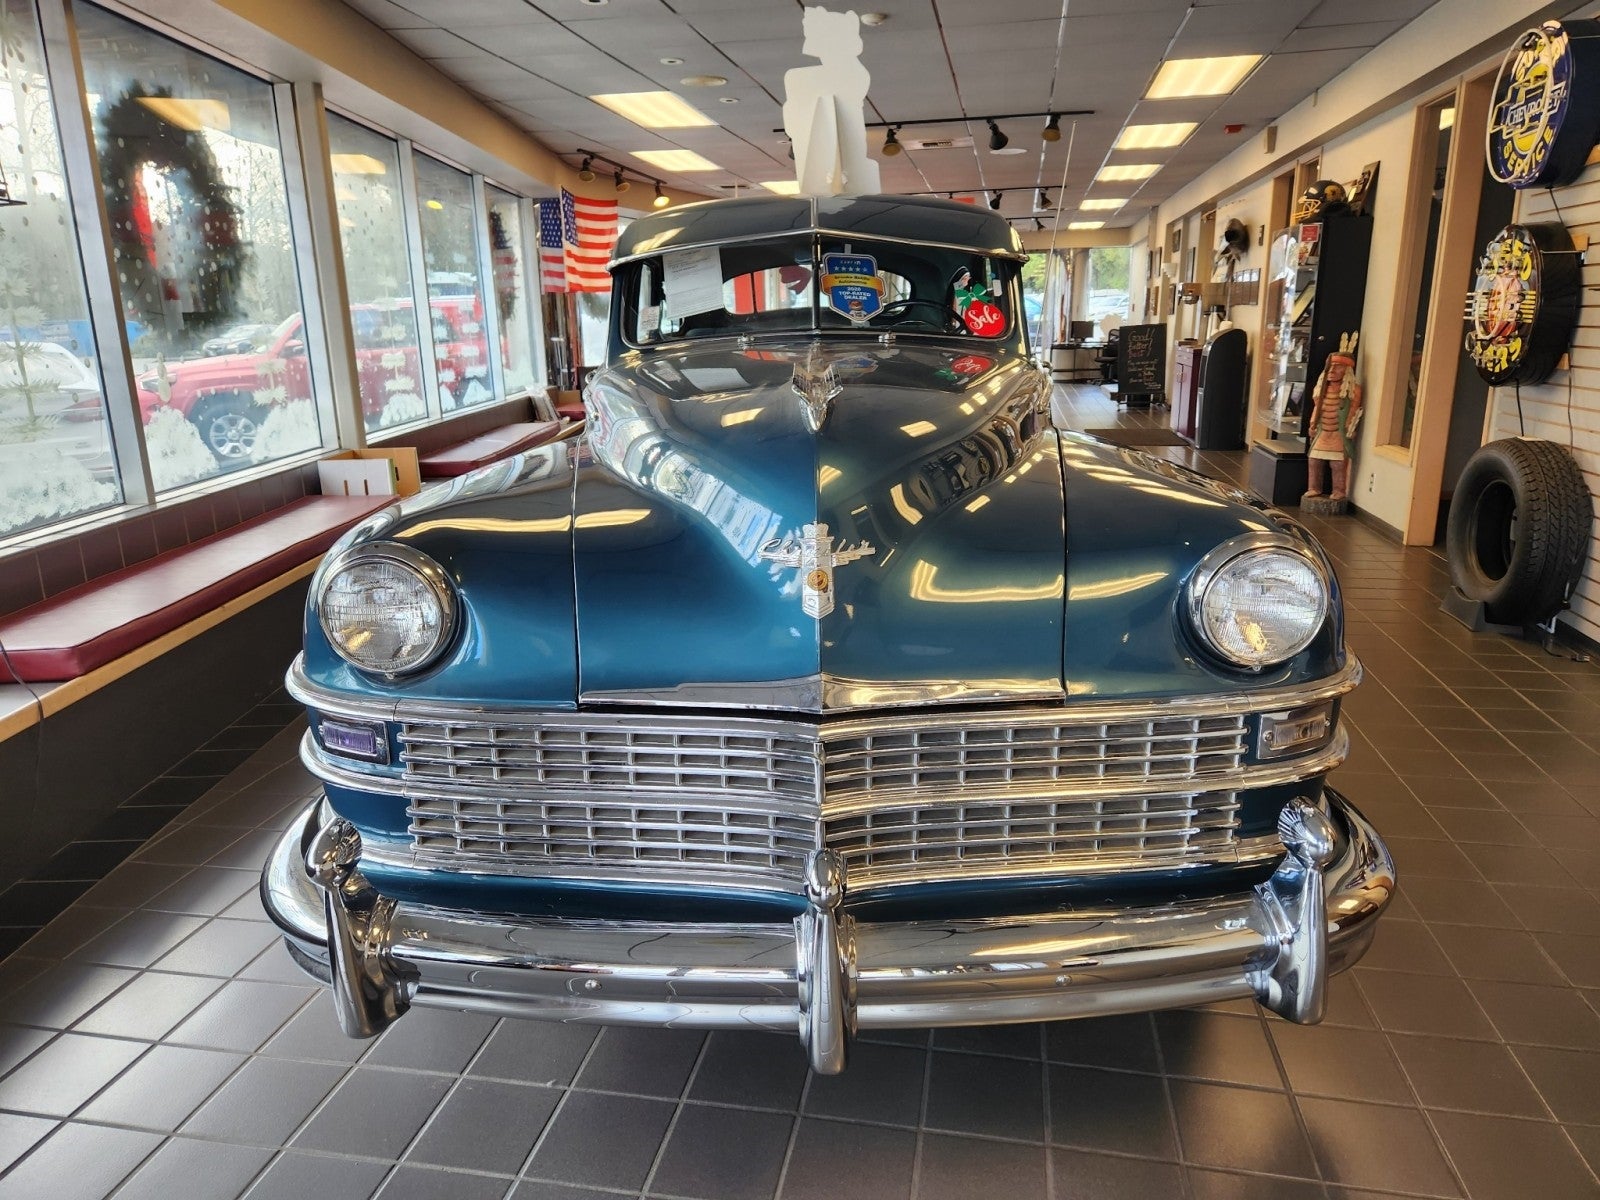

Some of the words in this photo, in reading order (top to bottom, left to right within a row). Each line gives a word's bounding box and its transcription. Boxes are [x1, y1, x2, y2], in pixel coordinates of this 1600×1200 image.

[1505, 96, 1560, 127] CHEVROET
[1503, 126, 1553, 178] SERVICE
[968, 305, 1000, 330] Sale
[757, 538, 876, 560] Chrler
